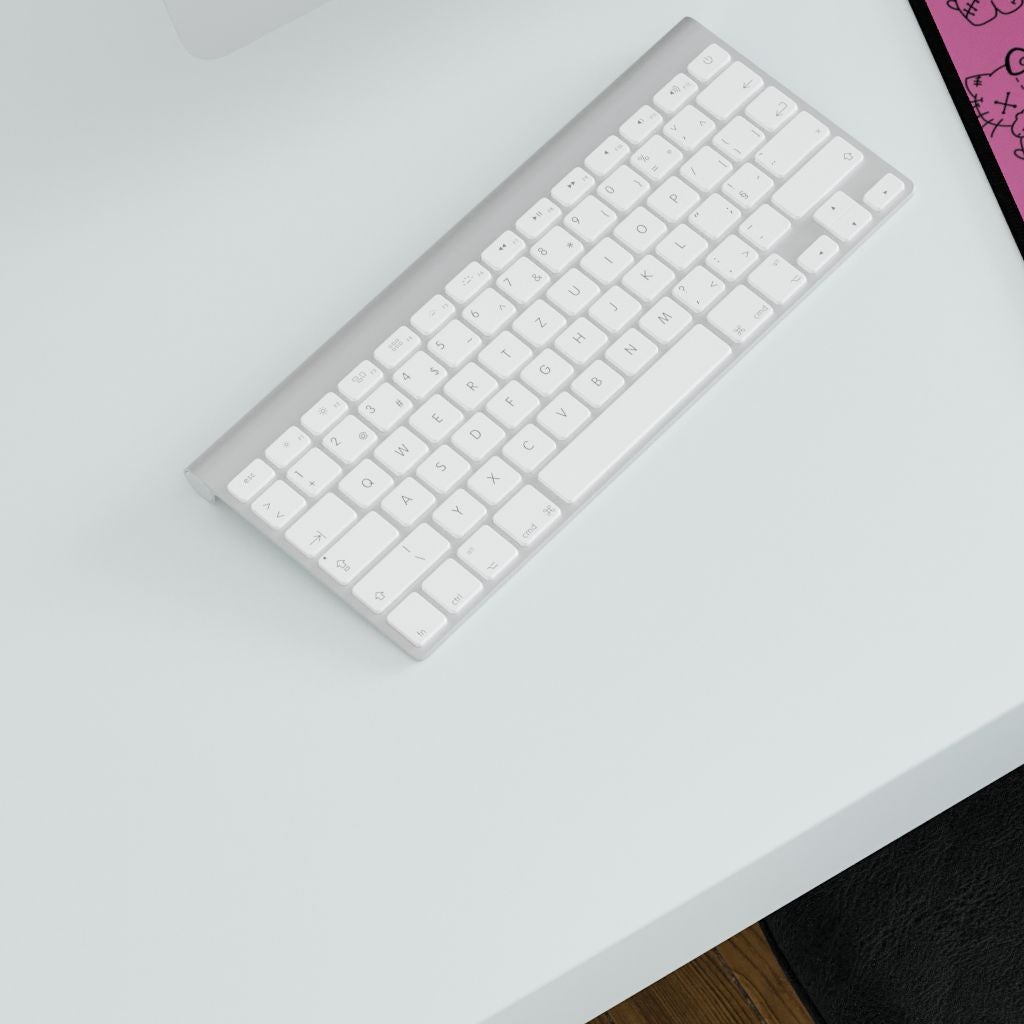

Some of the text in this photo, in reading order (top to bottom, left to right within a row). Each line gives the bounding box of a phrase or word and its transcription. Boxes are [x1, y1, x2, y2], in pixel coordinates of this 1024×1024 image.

[361, 478, 375, 489] Q
[394, 443, 409, 457] W
[431, 412, 444, 424] E
[465, 381, 478, 391] R
[500, 348, 512, 358] T
[534, 316, 548, 329] Z
[567, 285, 581, 297] U
[636, 224, 648, 234] O
[668, 193, 678, 204] P
[401, 495, 414, 507] A
[435, 461, 447, 472] S
[469, 429, 482, 441] D
[504, 396, 515, 407] F
[539, 364, 552, 375] G
[572, 332, 587, 344] H
[608, 301, 618, 312] J
[640, 270, 653, 281] K
[674, 241, 687, 249] L
[451, 505, 463, 516] Y
[486, 472, 501, 486] X
[522, 440, 535, 451] C
[555, 407, 567, 417] V
[590, 376, 603, 387] B
[623, 343, 638, 356] N
[657, 311, 673, 325] M
